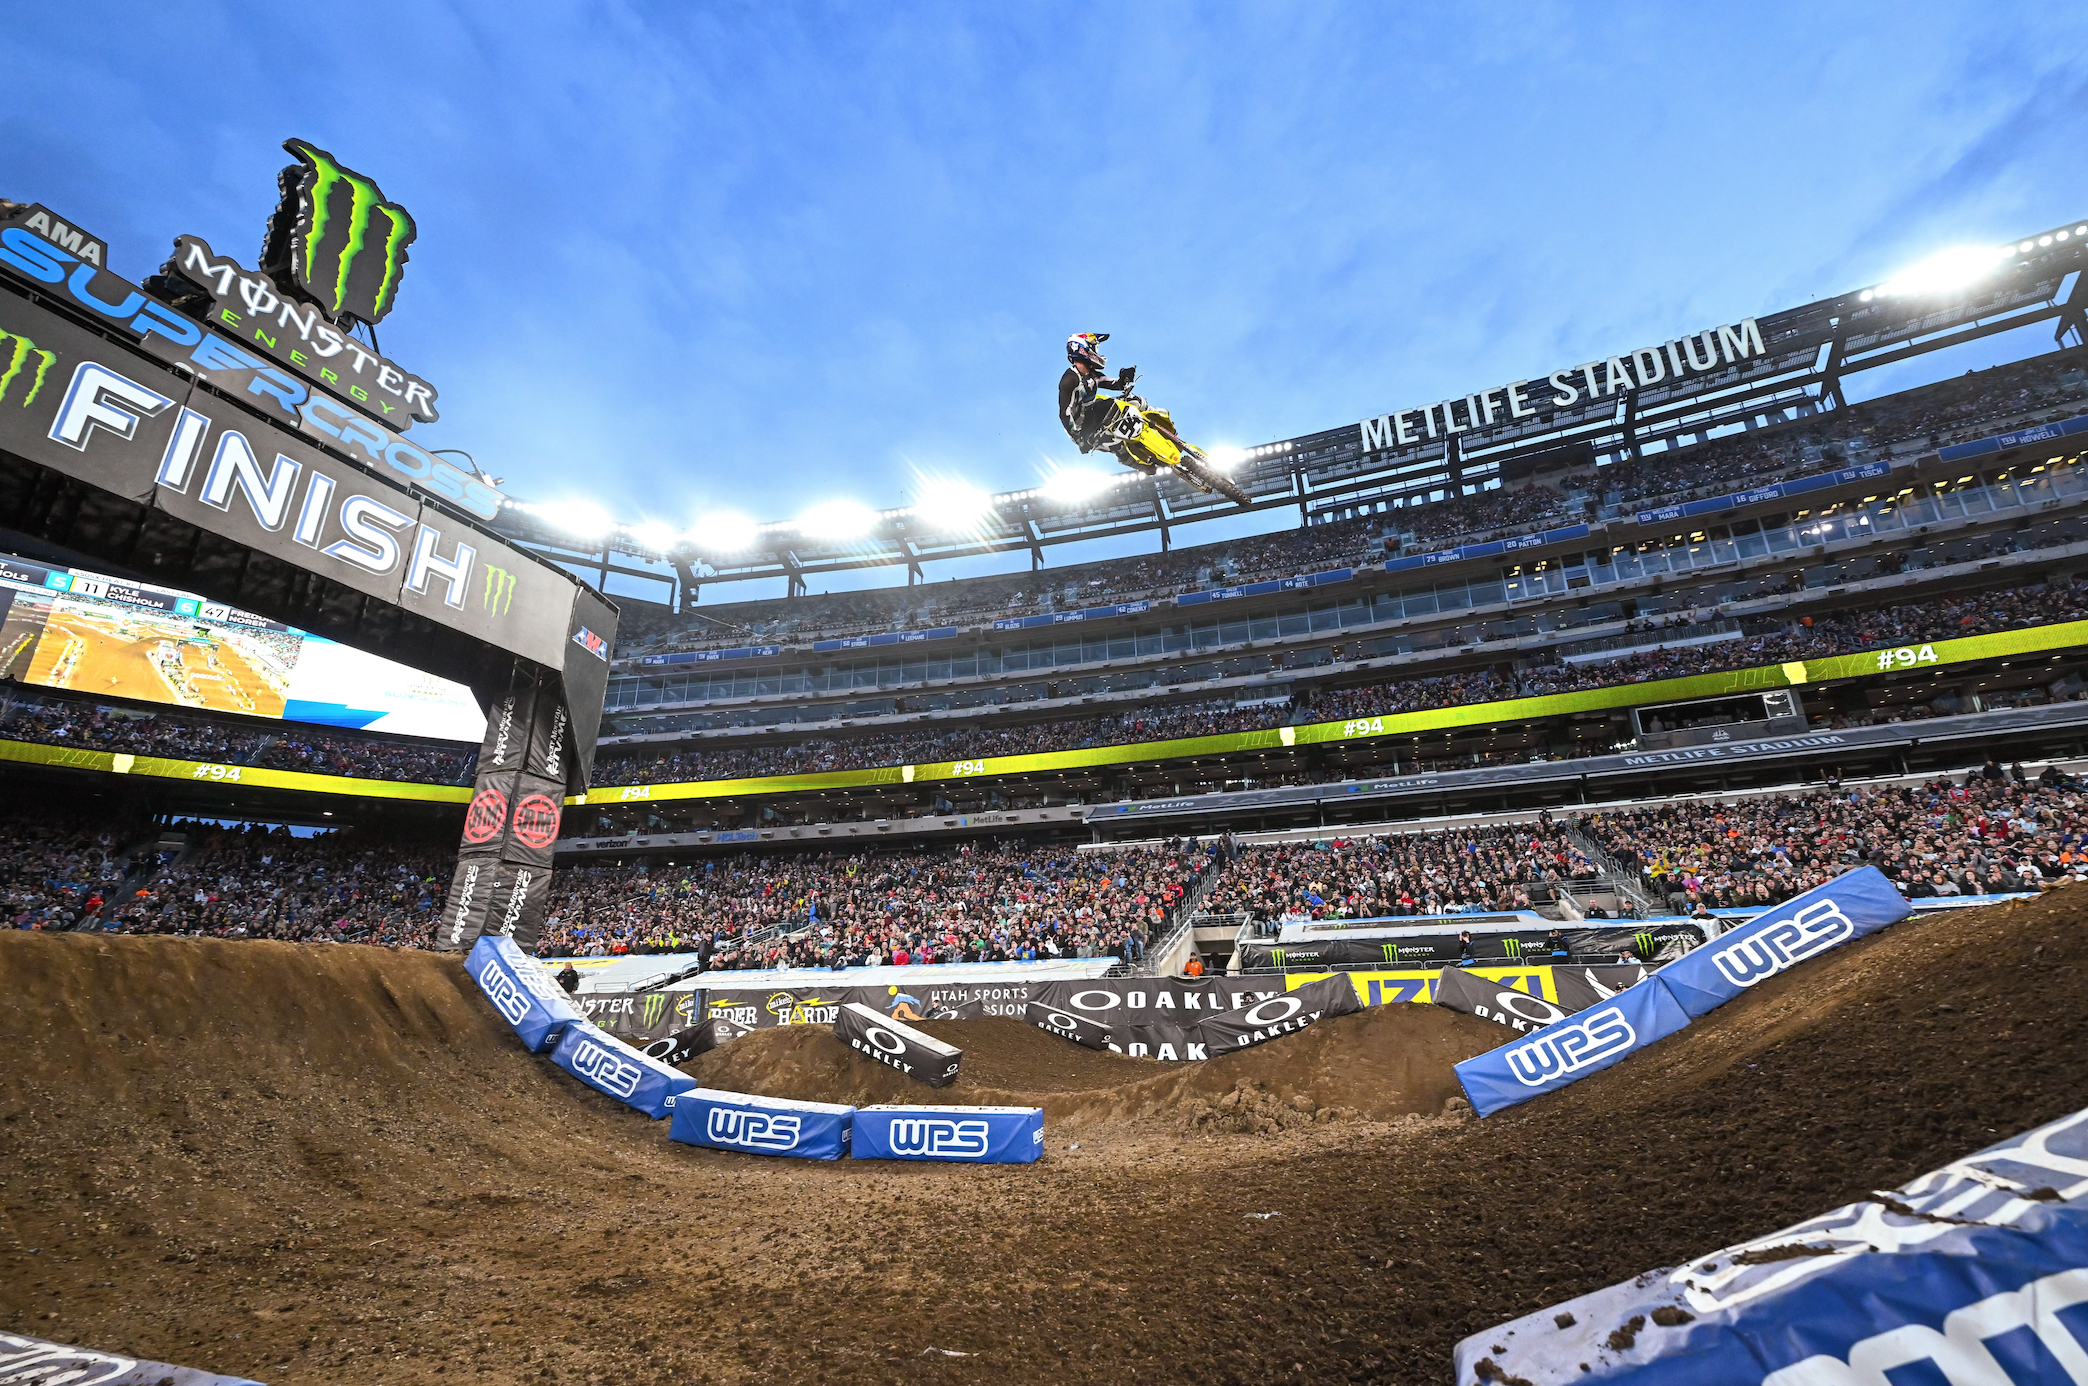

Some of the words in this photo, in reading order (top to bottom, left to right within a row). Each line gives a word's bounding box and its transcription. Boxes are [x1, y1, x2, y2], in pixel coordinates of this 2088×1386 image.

[25, 211, 101, 266] AMA
[184, 243, 434, 418] MONSTER
[220, 308, 396, 414] ENERGY
[0, 227, 497, 517] SUPERCROSS
[1359, 379, 1537, 453] METLIFE
[1548, 317, 1767, 406] STADIUM
[2019, 431, 2057, 444] HOWELL
[1859, 467, 1883, 478] TISCH
[47, 360, 478, 612] FINISH
[1736, 495, 1746, 503] 16
[1749, 491, 1779, 502] GIFFORD
[1658, 510, 1679, 521] MARA
[1518, 538, 1542, 549] PATTON
[1438, 553, 1460, 563] BROWN
[52, 576, 66, 588] 5
[84, 583, 98, 594] 11
[110, 586, 139, 596] KYLE
[107, 592, 164, 608] CHISHOLM
[180, 602, 193, 613] 6
[205, 608, 224, 618] 47
[228, 615, 267, 628] NOREN
[572, 626, 608, 661] AMA
[1877, 645, 1938, 669] #94
[1344, 718, 1384, 737] #94
[494, 733, 503, 755] ROCKY
[546, 740, 555, 763] ROCKY
[1625, 748, 1729, 766] METLIFE
[1733, 735, 1846, 755] STADIUM
[193, 764, 242, 782] #94
[952, 760, 985, 776] #94
[621, 786, 650, 800] #94
[1374, 778, 1438, 790] MetLife
[1139, 801, 1195, 811] MetLife
[973, 815, 1003, 825] MetLife
[596, 840, 627, 849] verizon
[716, 831, 758, 842] HCLTech
[453, 907, 464, 932] ROCKY
[459, 865, 473, 906] MOUNTAIN
[500, 907, 513, 934] ROCKY
[508, 869, 524, 907] MOUNTAIN
[1653, 934, 1697, 943] MONSTER
[1712, 899, 1854, 988] WPS
[1285, 951, 1320, 959] MONSTER
[1398, 946, 1435, 954] MONSTER
[479, 959, 532, 1026] WPS
[931, 990, 967, 1001] UTAH
[974, 988, 1028, 1000] SPORTS
[1127, 991, 1276, 1010] OAKLEY
[575, 996, 634, 1015] NSTER
[777, 1005, 840, 1026] HARDE
[1474, 1004, 1540, 1031] OAK
[1037, 1021, 1082, 1042] OAKLEY
[1237, 1010, 1321, 1046] OAKLEY
[852, 1038, 913, 1073] OAKLEY
[1129, 1042, 1208, 1061] OAK
[1505, 1007, 1636, 1087] WPS
[572, 1039, 642, 1098] WPS
[706, 1107, 802, 1150] WPS
[890, 1118, 989, 1158] WPS
